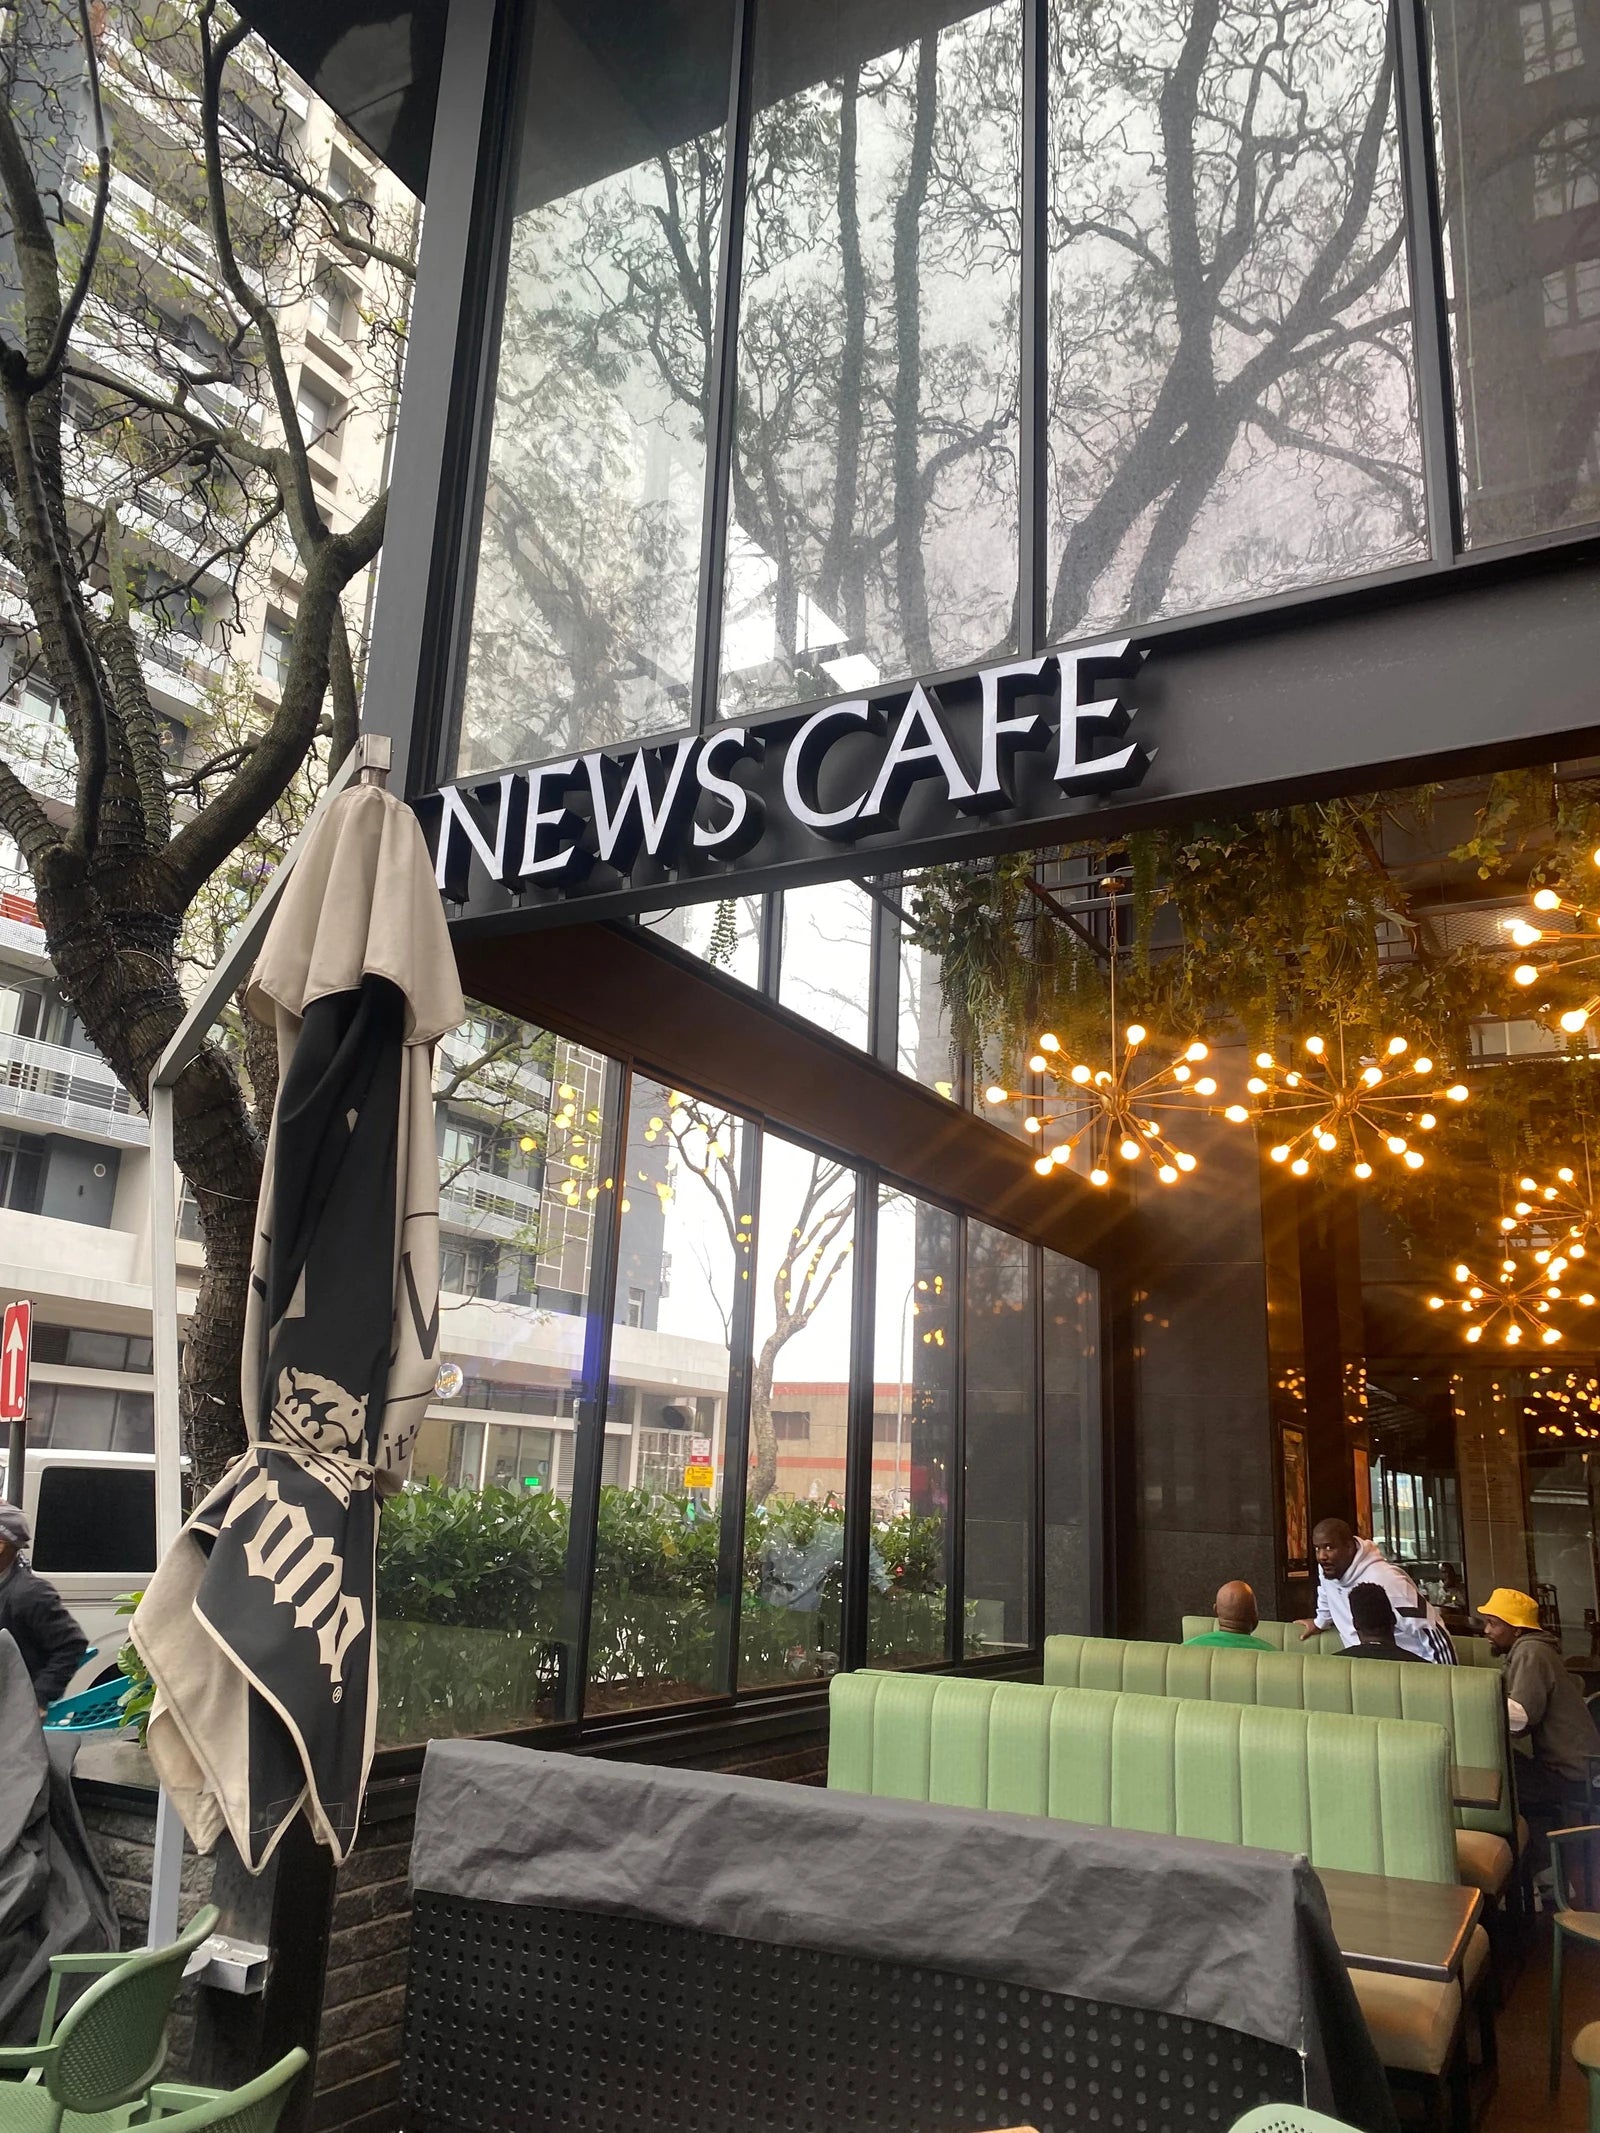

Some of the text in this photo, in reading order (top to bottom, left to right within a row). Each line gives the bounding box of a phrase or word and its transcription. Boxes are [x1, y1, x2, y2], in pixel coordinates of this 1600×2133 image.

[435, 638, 1139, 890] NEWS CAFE
[383, 1423, 418, 1470] it'
